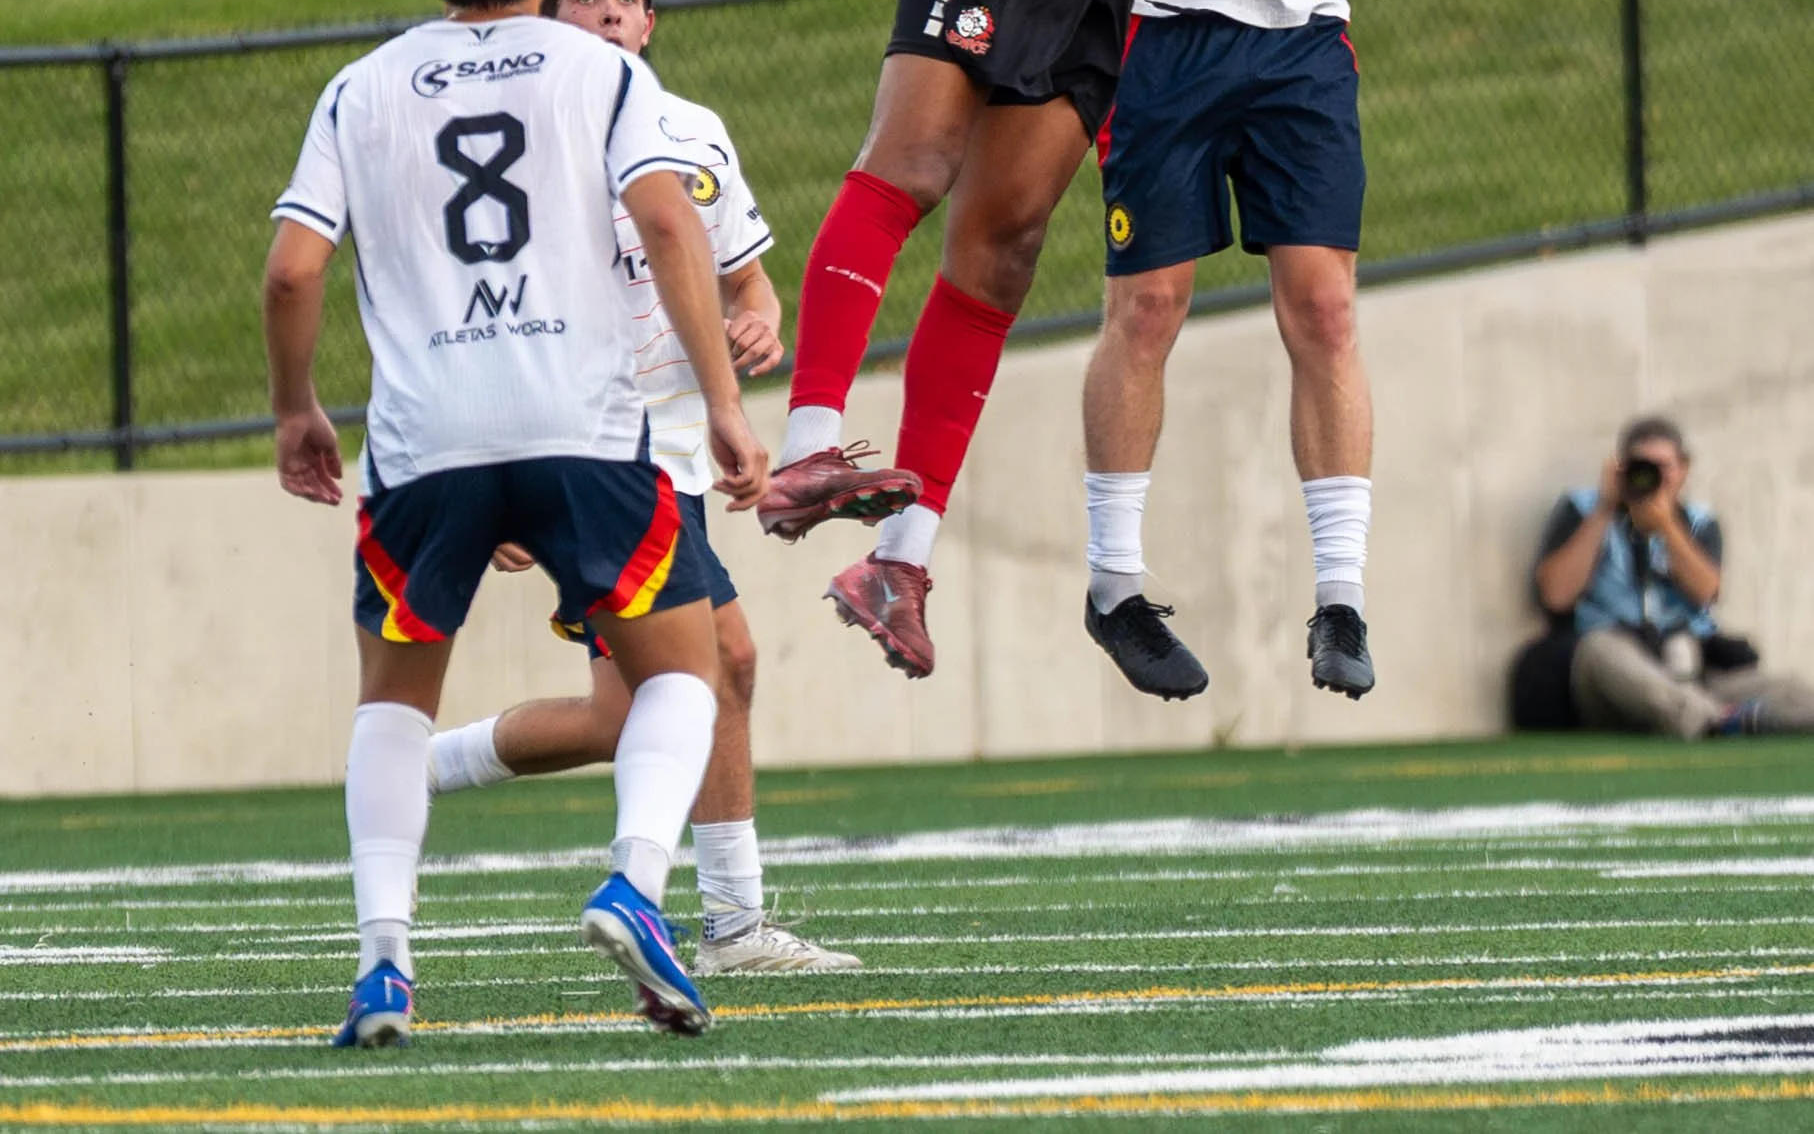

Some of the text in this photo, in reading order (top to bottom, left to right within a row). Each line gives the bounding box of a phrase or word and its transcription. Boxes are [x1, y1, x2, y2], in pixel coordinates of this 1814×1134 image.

[456, 52, 545, 77] SANO
[435, 112, 530, 265] 8
[428, 319, 566, 349] ATLETAS WORLD
